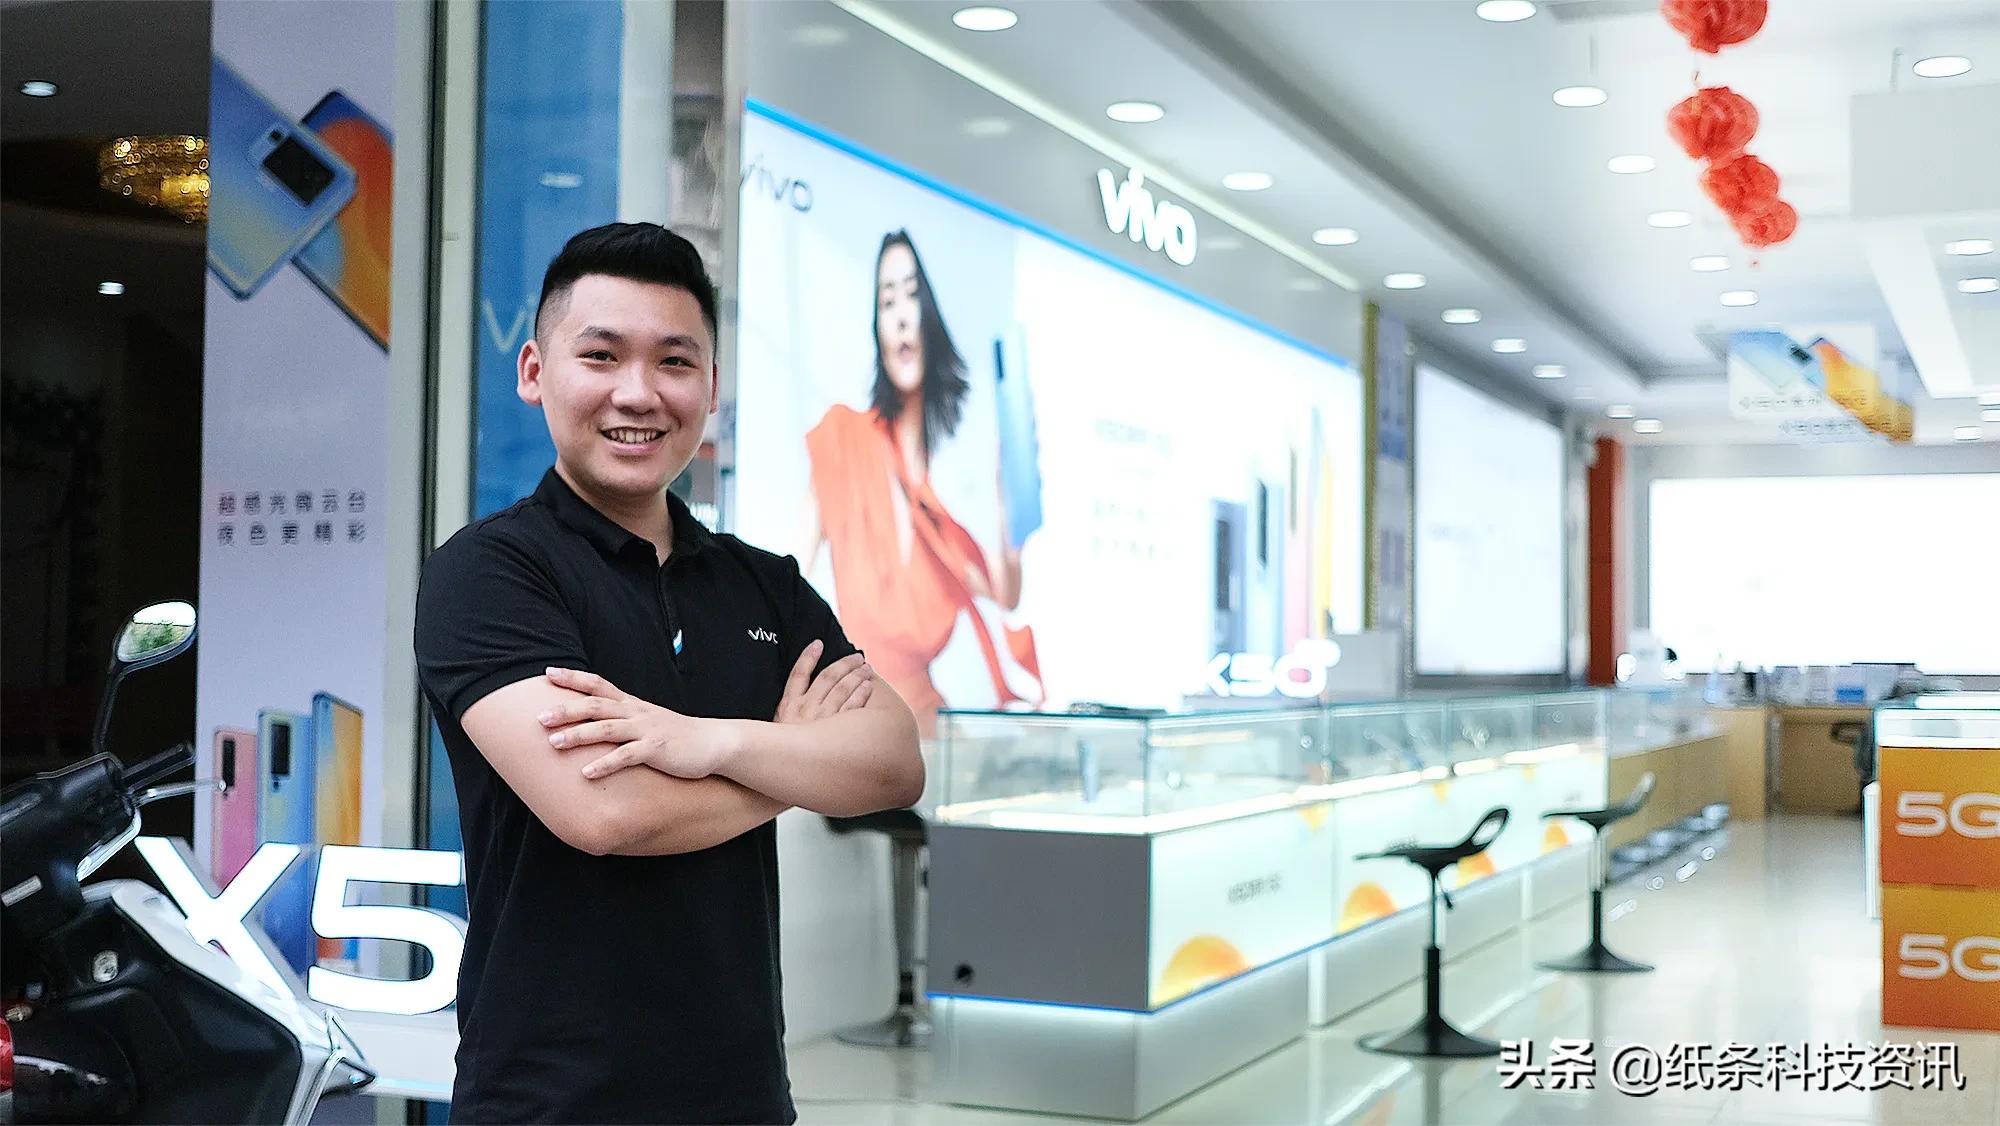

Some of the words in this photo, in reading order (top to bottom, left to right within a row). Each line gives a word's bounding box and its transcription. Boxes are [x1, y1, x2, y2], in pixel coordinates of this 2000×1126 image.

[1097, 167, 1197, 266] vivo
[1896, 791, 2000, 839] 5G
[1898, 934, 2000, 982] 5G
